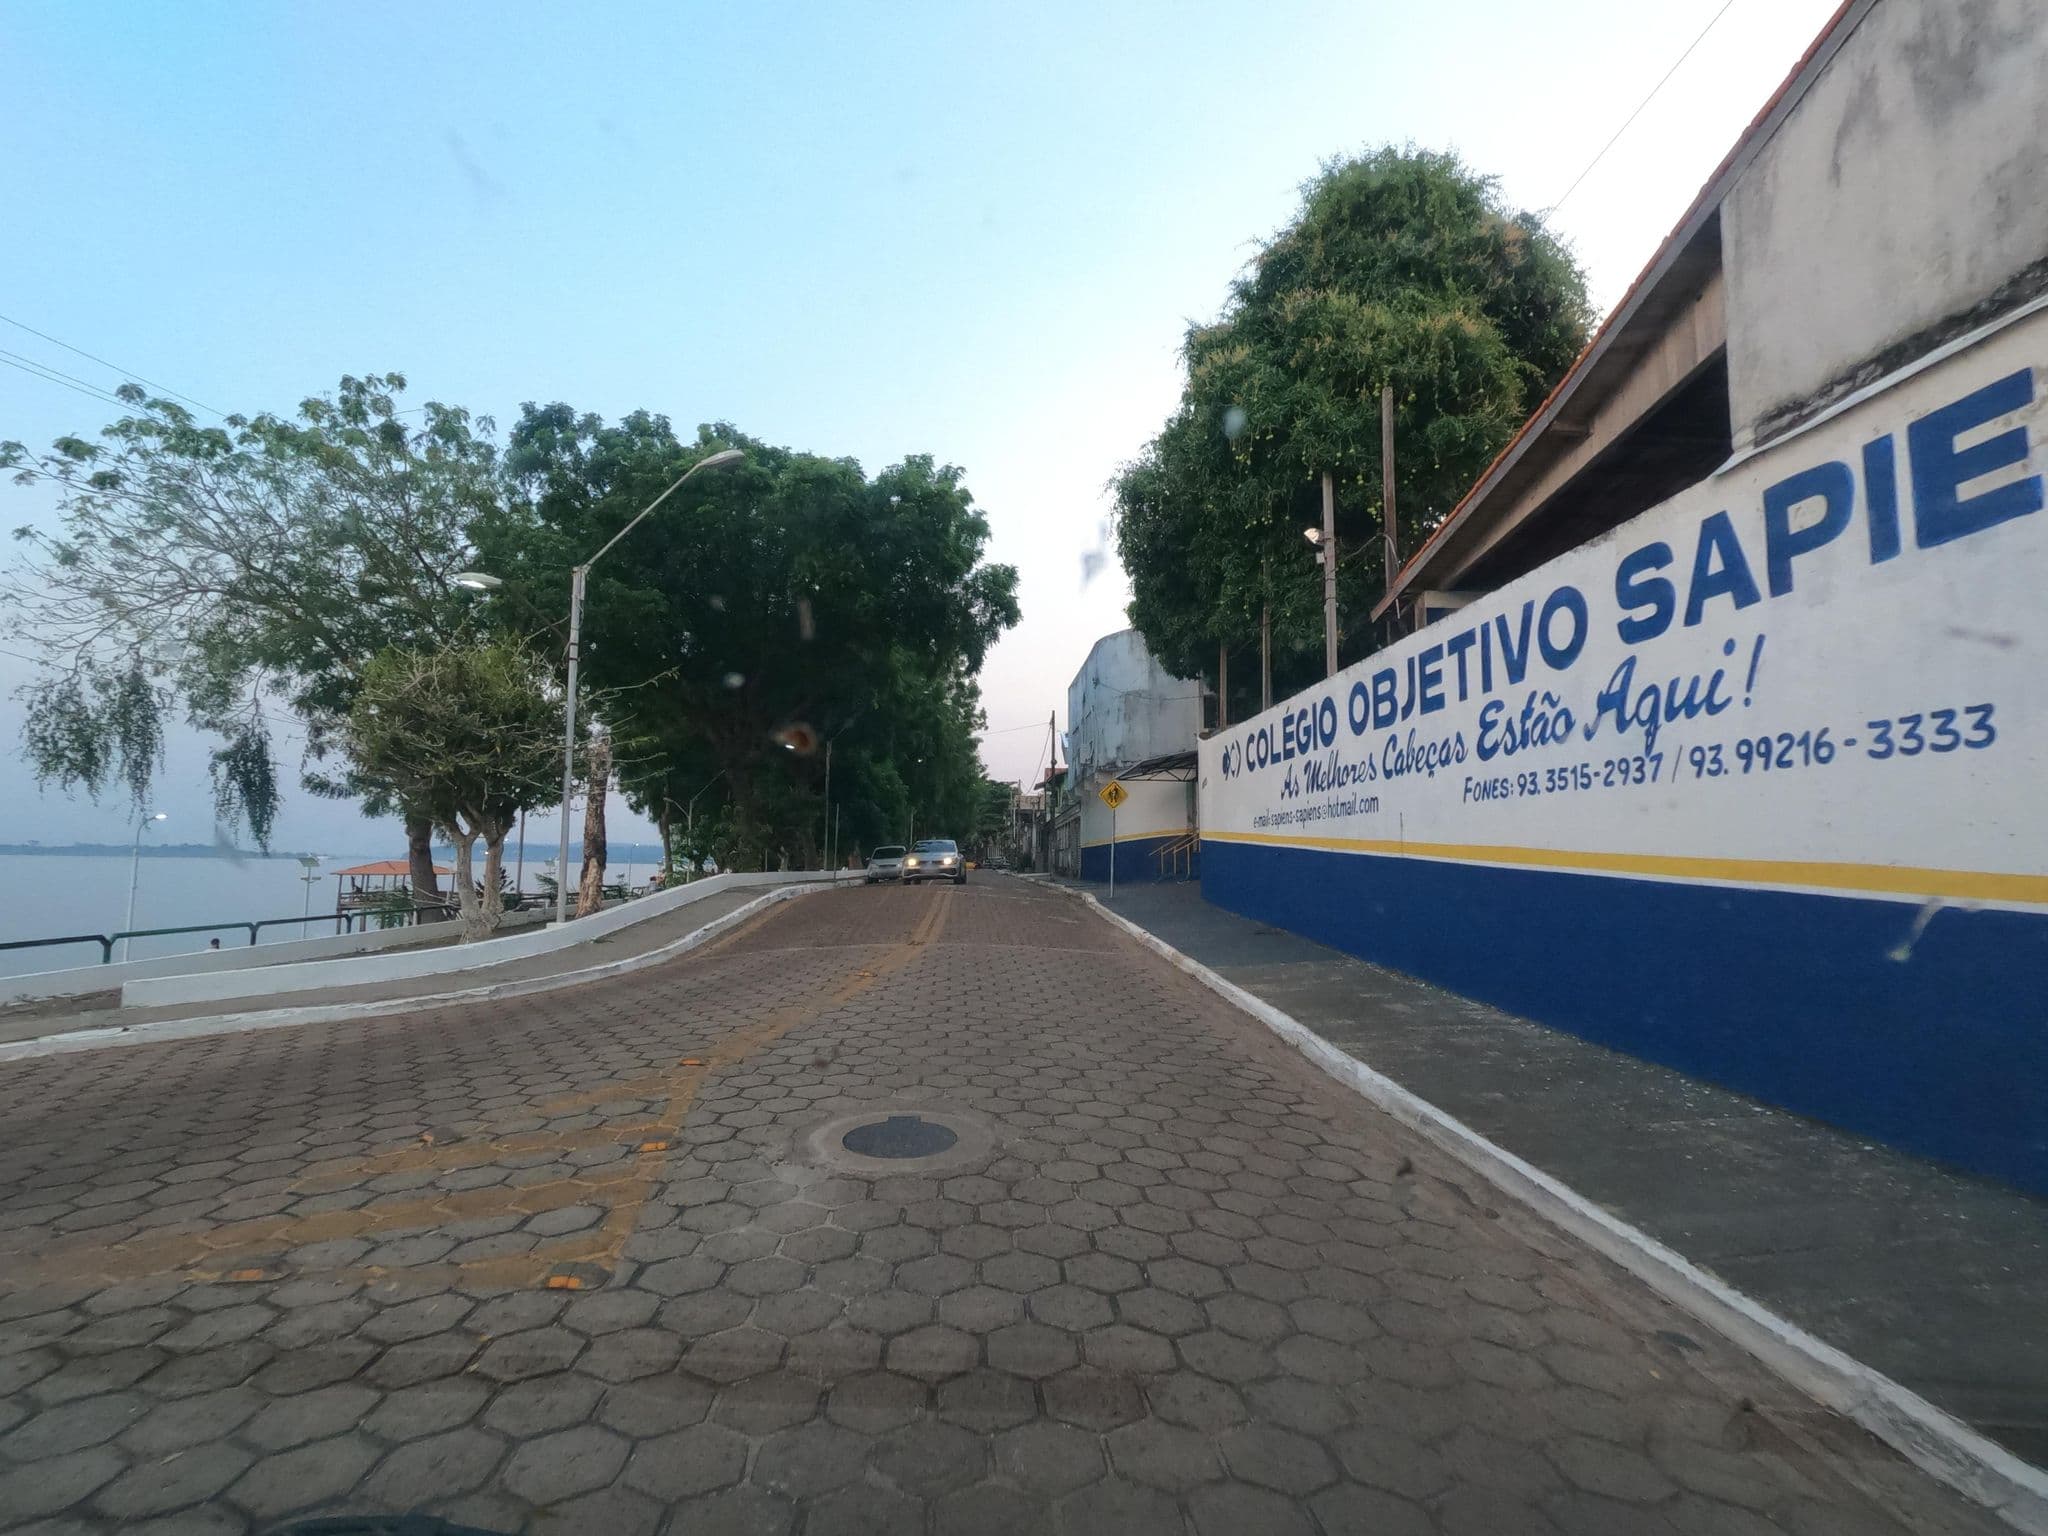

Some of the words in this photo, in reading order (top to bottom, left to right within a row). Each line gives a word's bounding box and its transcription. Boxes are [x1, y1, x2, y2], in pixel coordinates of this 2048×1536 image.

[1246, 696, 1337, 773] COLÉGIO
[1348, 584, 1589, 737] OBJETIVO
[1615, 367, 2043, 644] SAPIE
[1281, 763, 1300, 800] As
[1303, 750, 1377, 794] Melhores
[1383, 728, 1468, 779] Cabeças
[1476, 690, 1575, 762] Estão
